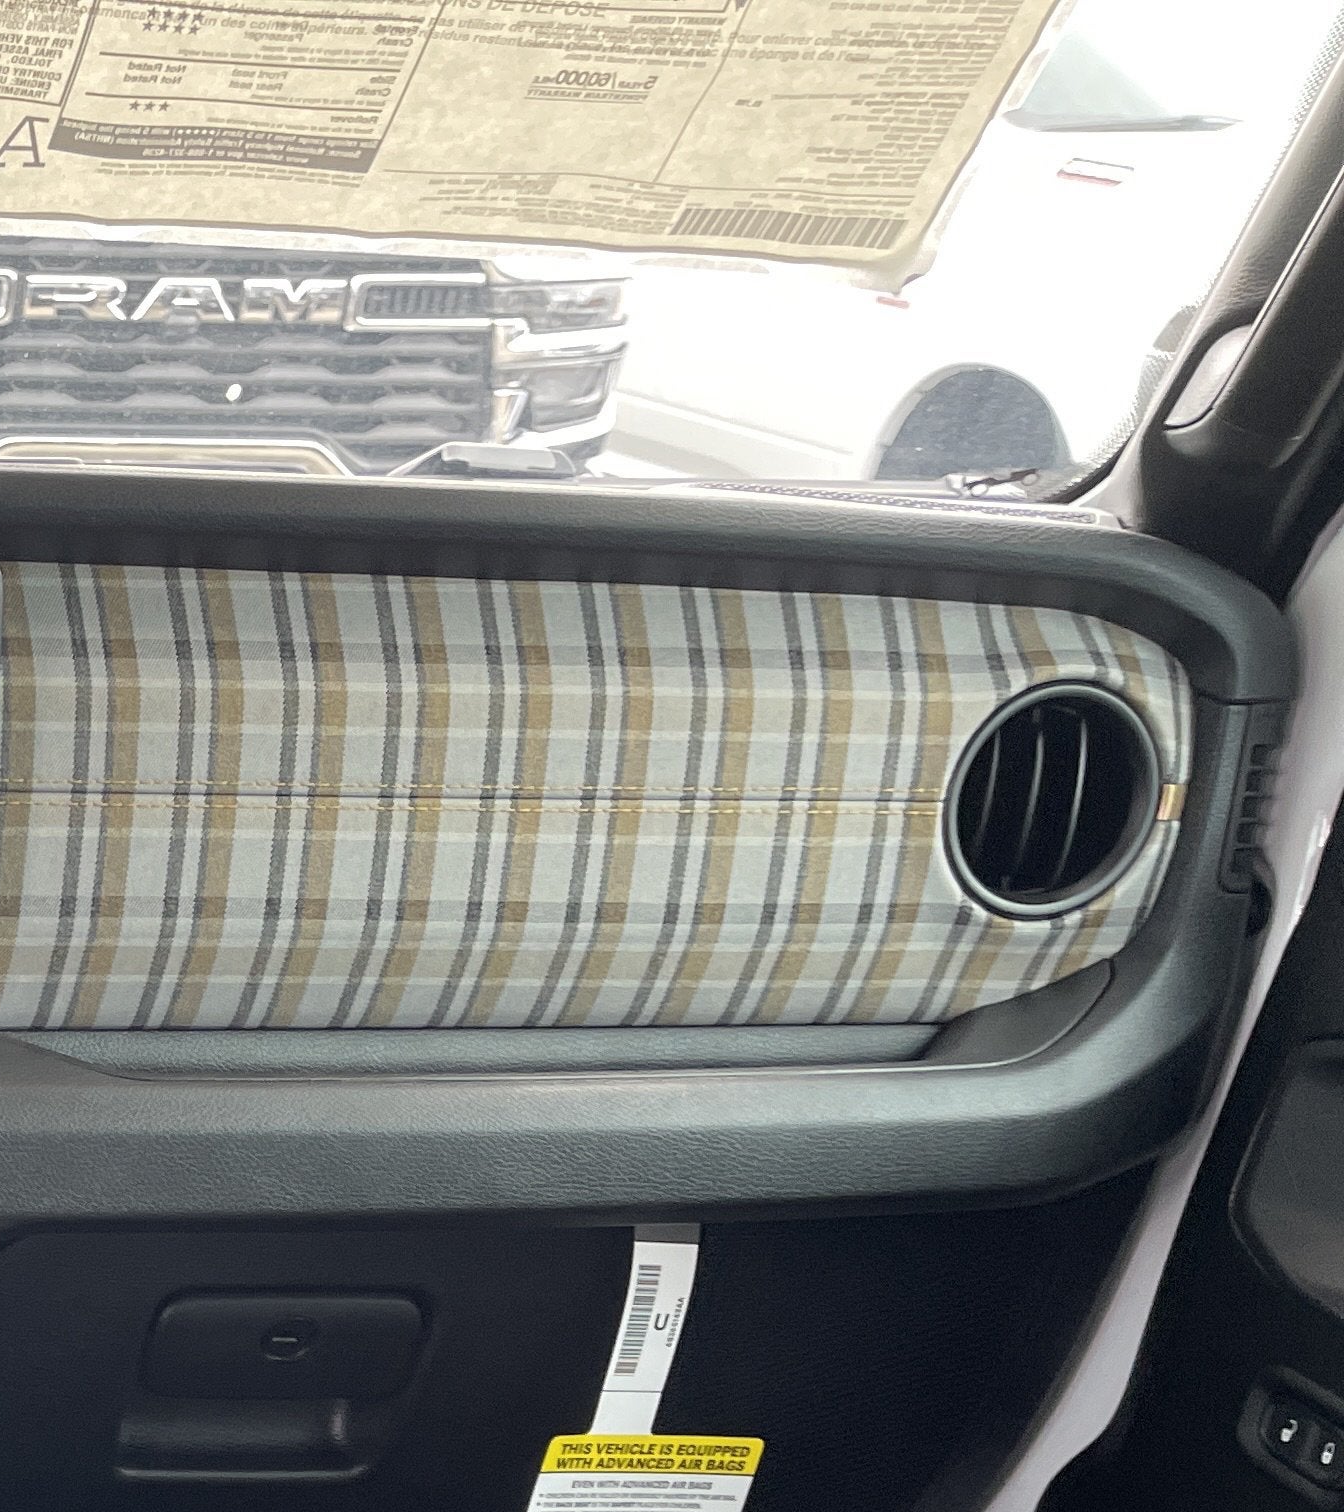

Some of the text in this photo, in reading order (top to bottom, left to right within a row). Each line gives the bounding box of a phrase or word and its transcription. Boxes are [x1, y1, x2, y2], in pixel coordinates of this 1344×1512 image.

[24, 273, 348, 325] RAM
[560, 1442, 751, 1459] THIS VEHICLE IS EQUIPPED
[555, 1457, 747, 1473] WITH ADVANCED AIR BAGS
